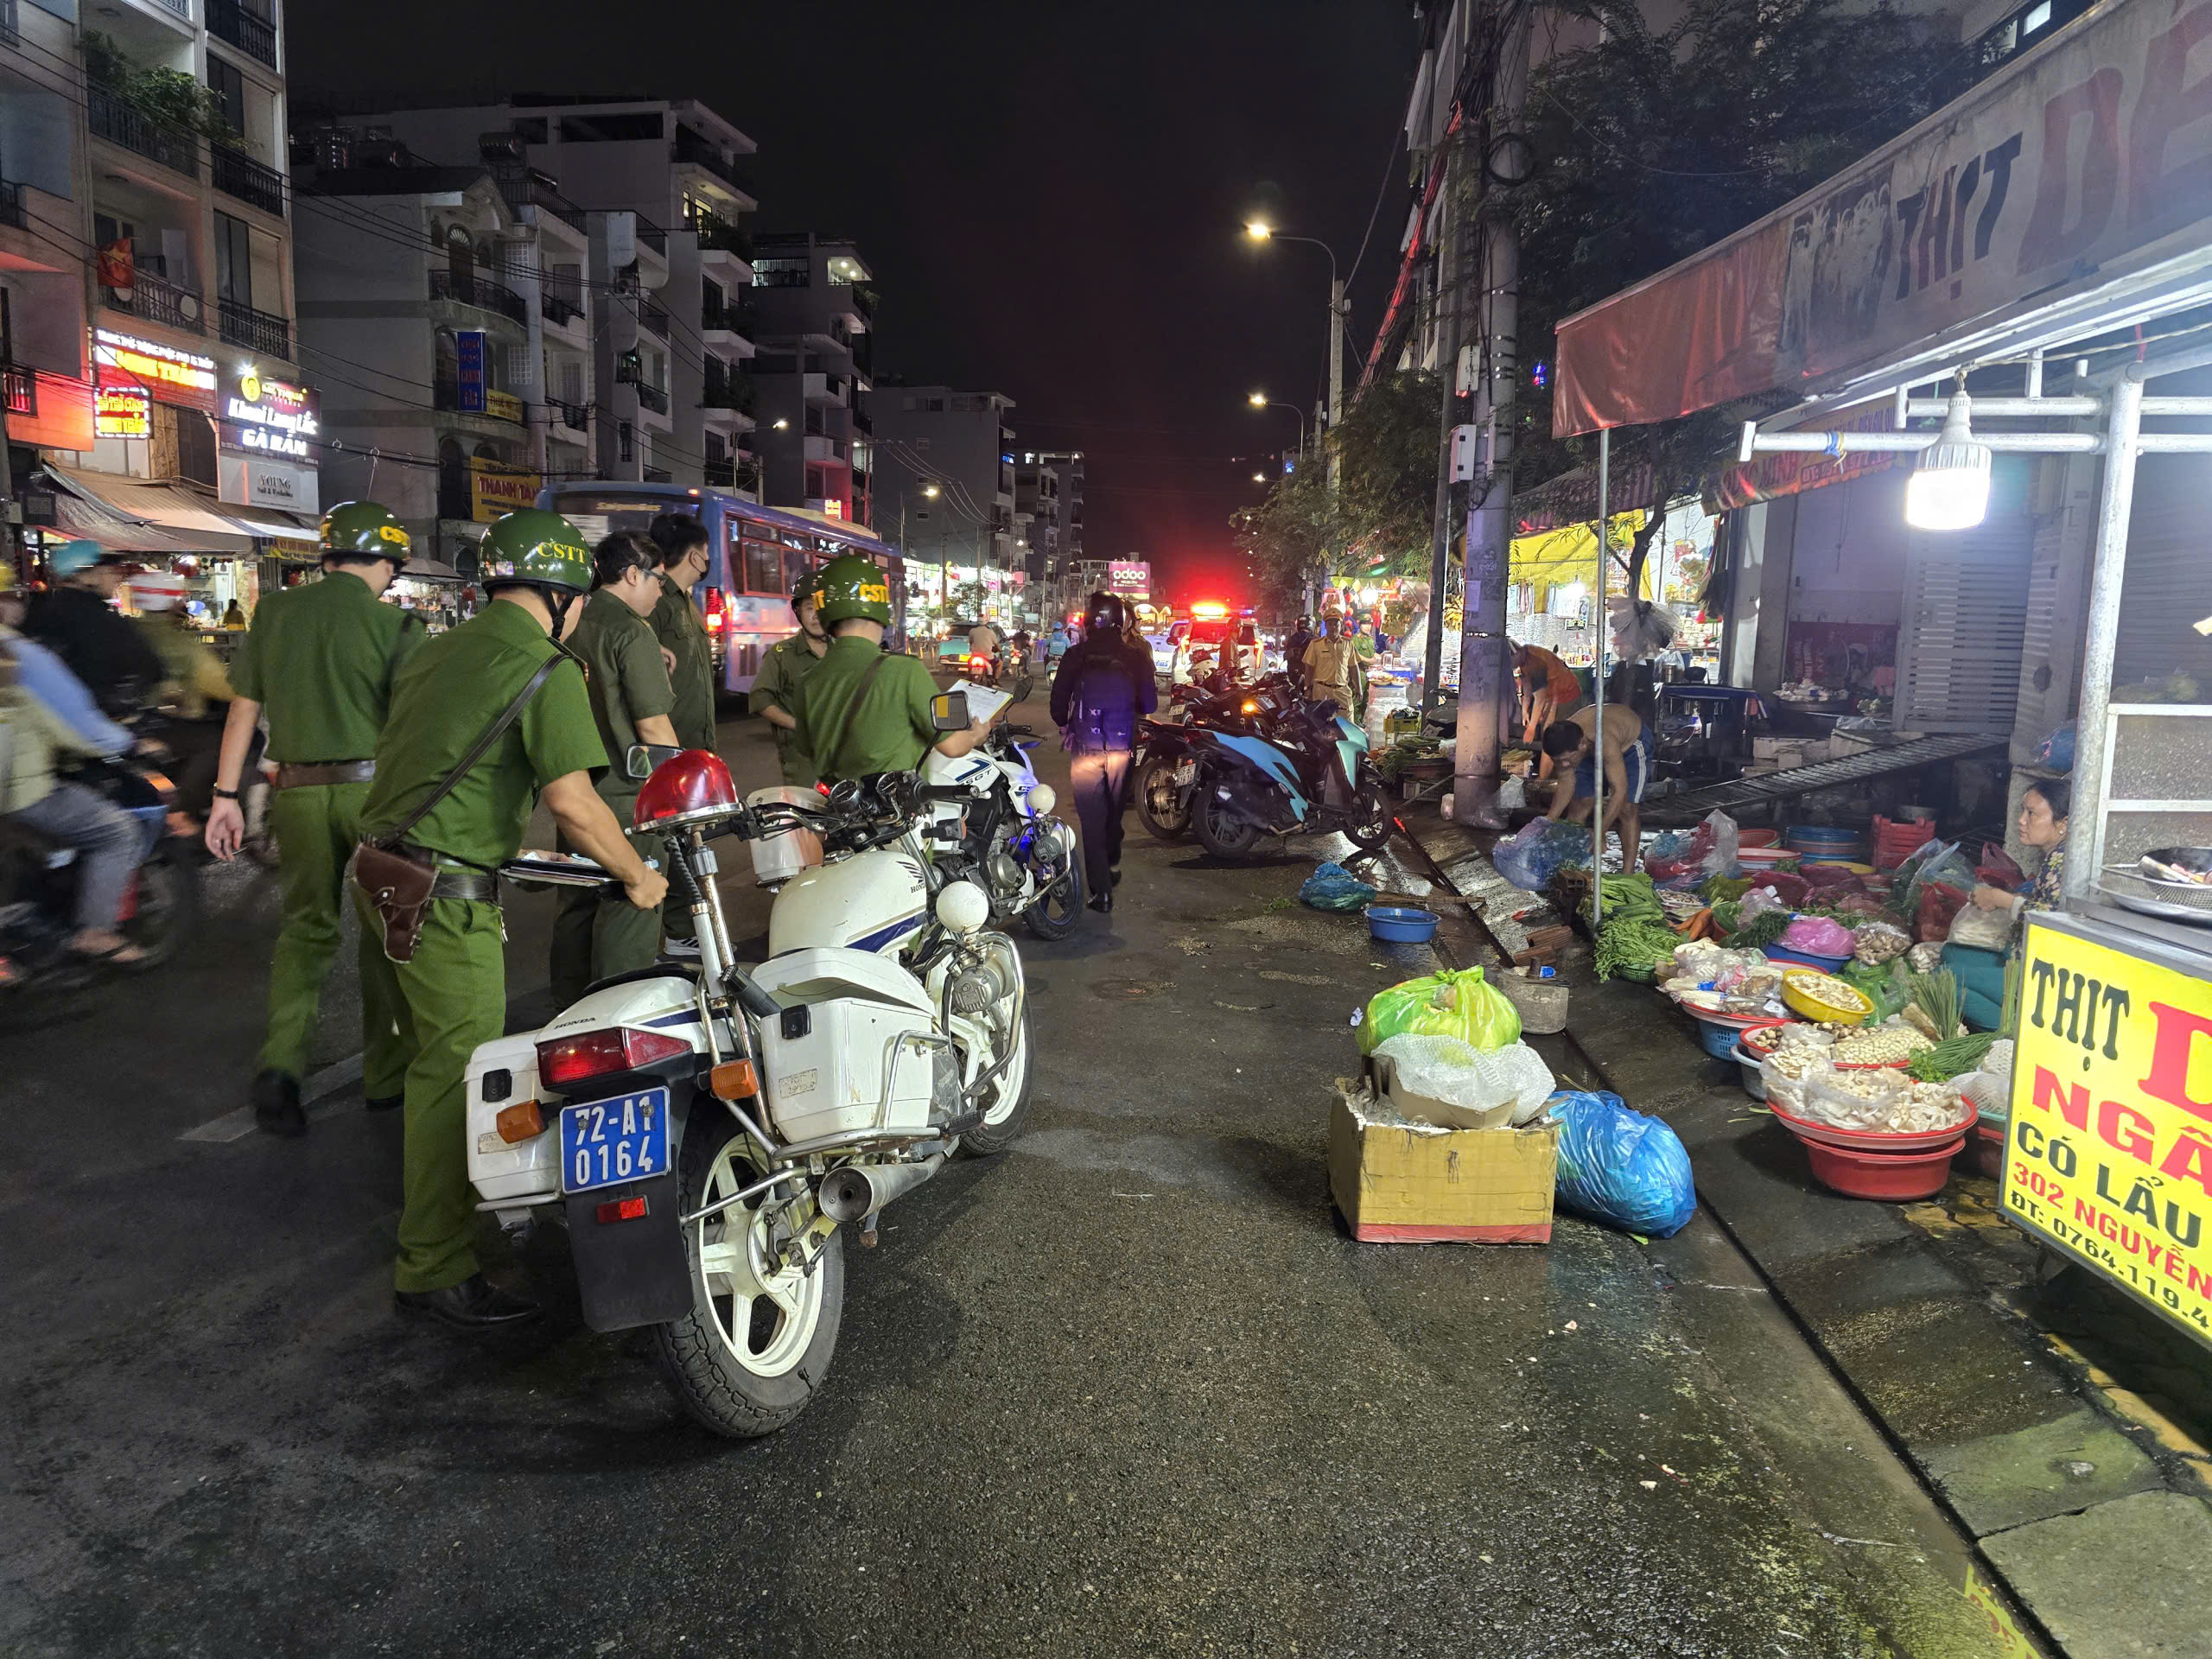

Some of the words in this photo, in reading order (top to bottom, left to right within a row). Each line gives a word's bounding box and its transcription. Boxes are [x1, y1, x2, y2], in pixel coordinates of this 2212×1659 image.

[1895, 131, 2023, 302] THỊT
[260, 474, 291, 490] YOUNG
[538, 542, 585, 563] CSTT
[1113, 568, 1147, 581] odoo
[553, 1017, 596, 1030] HONDA
[2031, 957, 2130, 1071] THỊT
[575, 1096, 652, 1146] 72-A1
[575, 1135, 653, 1185] 0164
[2017, 1121, 2076, 1179] CÓ
[2096, 1162, 2202, 1249] LẨU
[2011, 1189, 2044, 1224] ĐT:
[2012, 1160, 2063, 1211] 302
[2075, 1198, 2212, 1303] NGUYỄN
